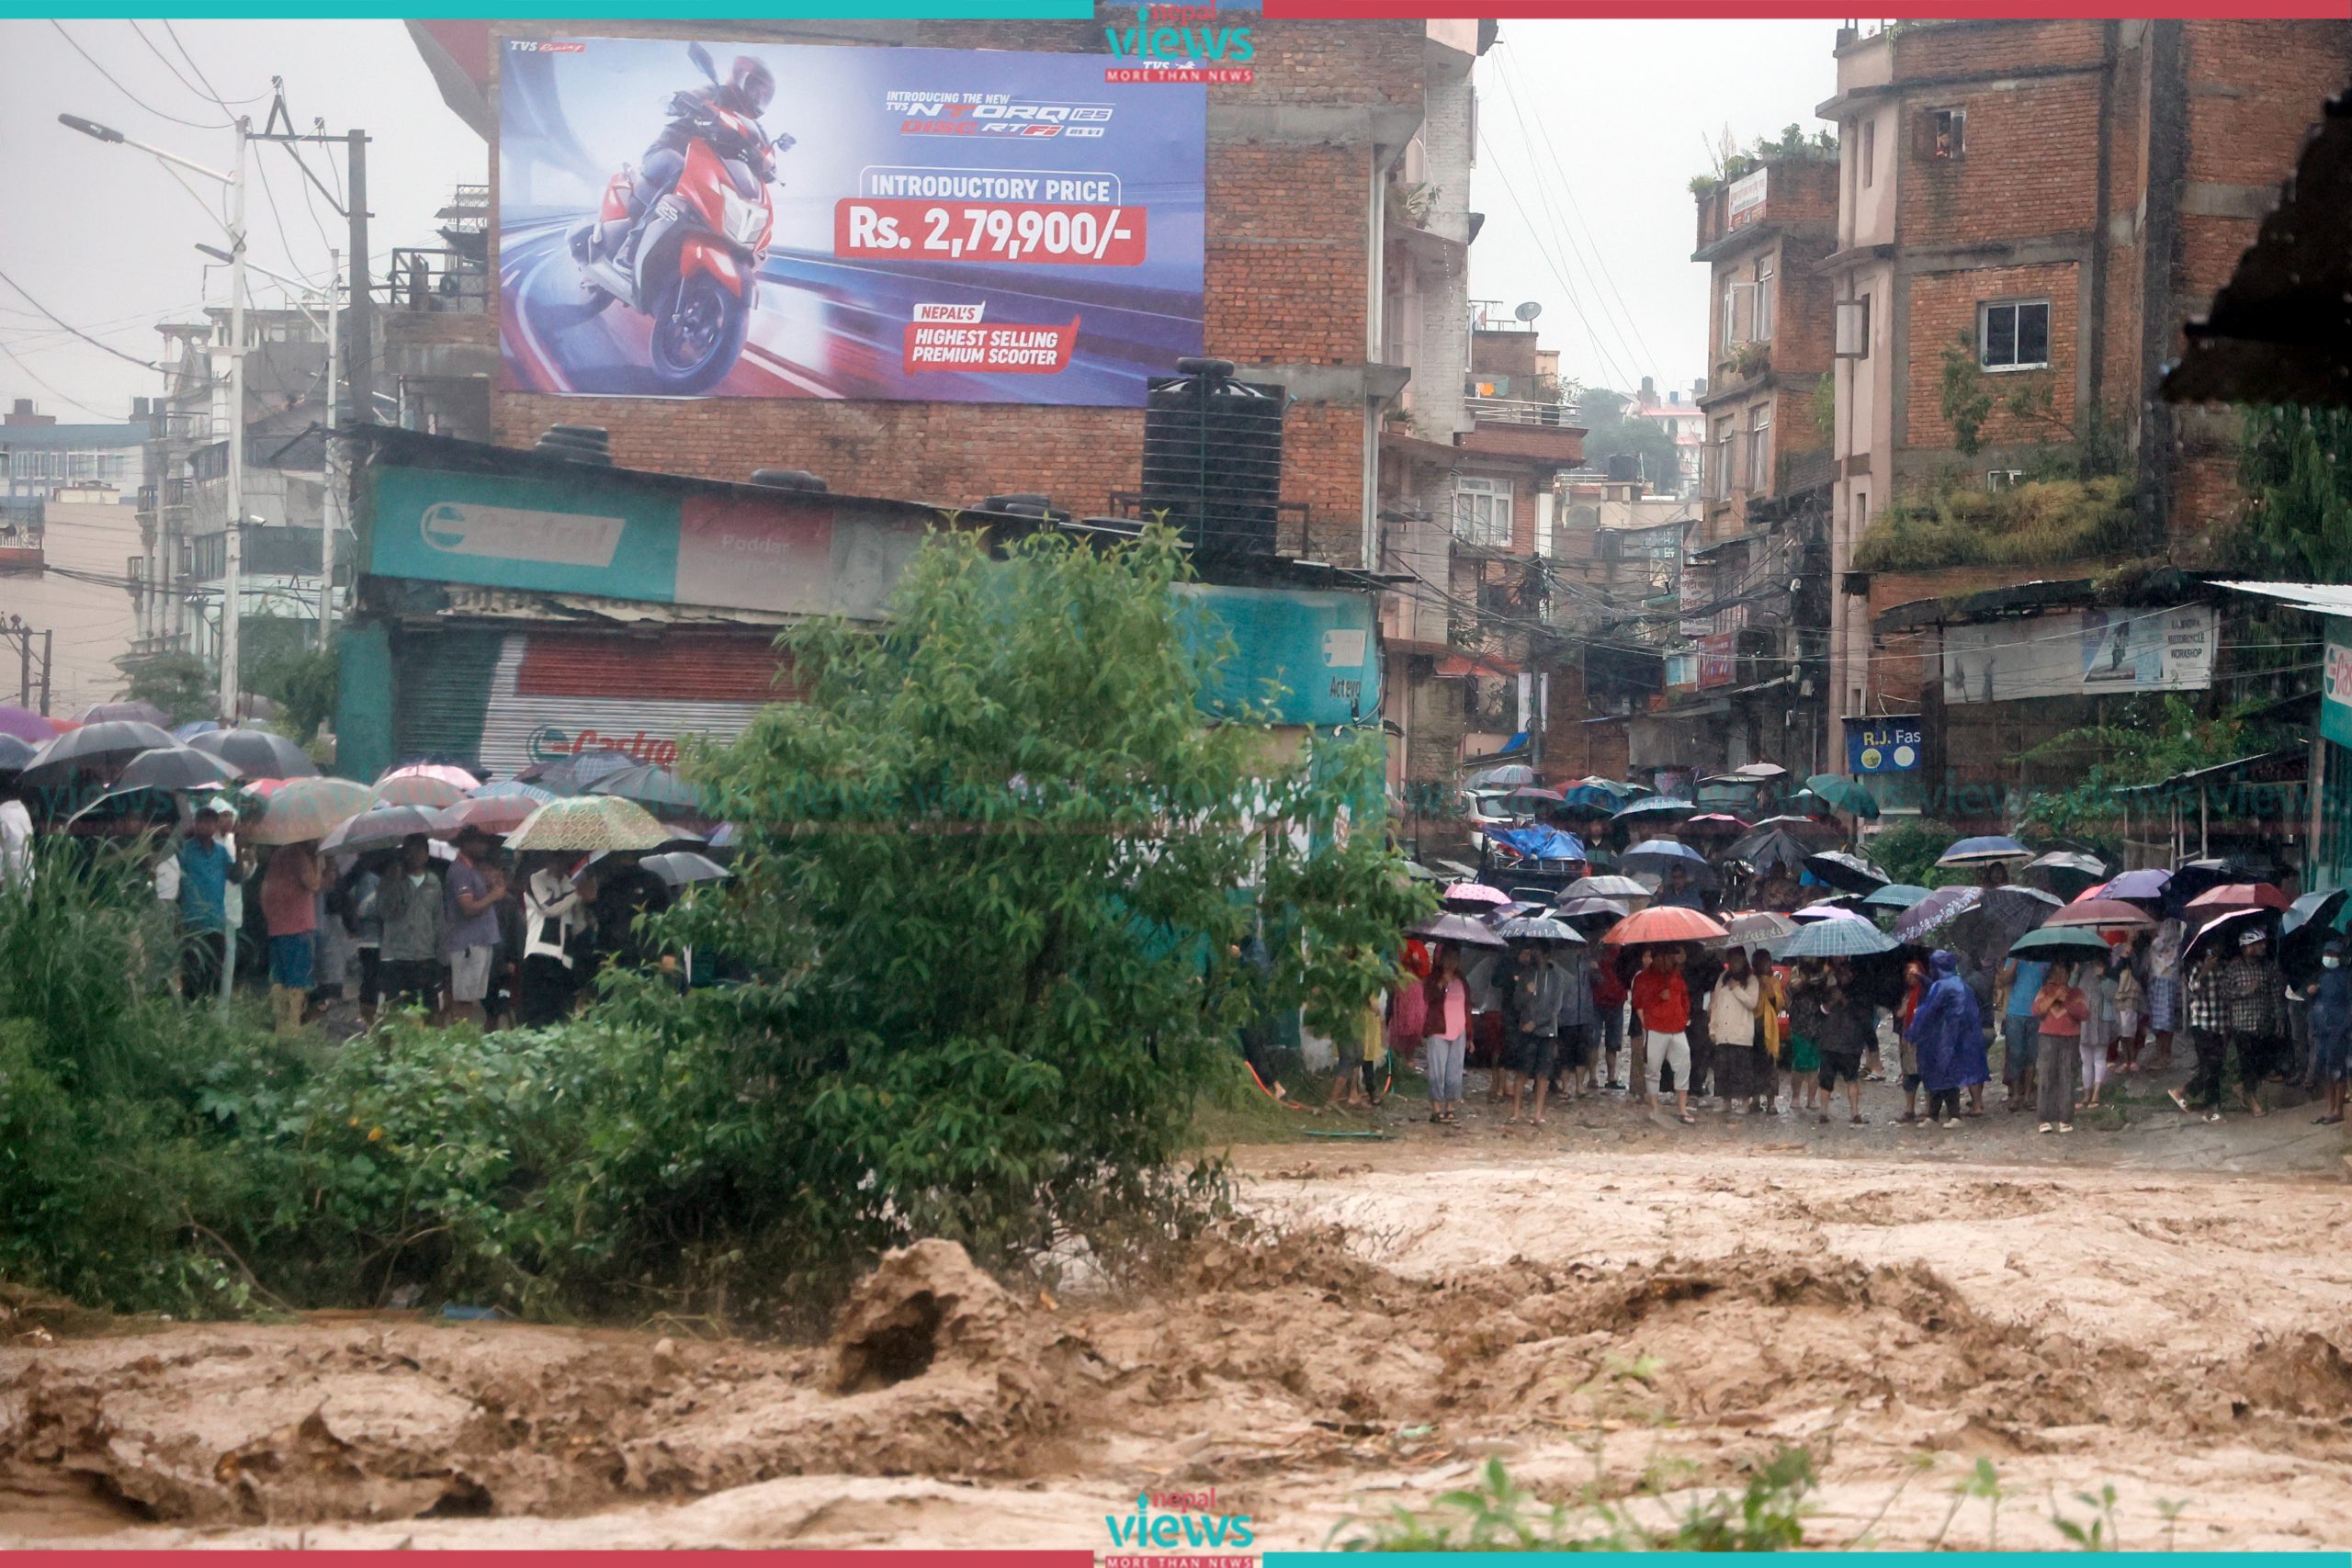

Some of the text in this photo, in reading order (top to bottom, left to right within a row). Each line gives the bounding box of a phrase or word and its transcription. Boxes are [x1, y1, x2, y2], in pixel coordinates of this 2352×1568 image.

[511, 40, 537, 51] TVS
[887, 91, 1011, 105] INTRODUCING THE NEW
[885, 102, 1111, 124] TVS NTORQ 125
[899, 120, 978, 134] DISC
[872, 175, 1110, 202] INTRODUCTORY PRICE
[849, 206, 1131, 259] Rs. 2,79,900/-
[921, 306, 976, 321] NEPAL'S
[915, 329, 1058, 348] HIGHEST SELLING
[912, 346, 1057, 366] PREMIUM SCOOTER
[1863, 728, 1922, 746] R.J. Fas
